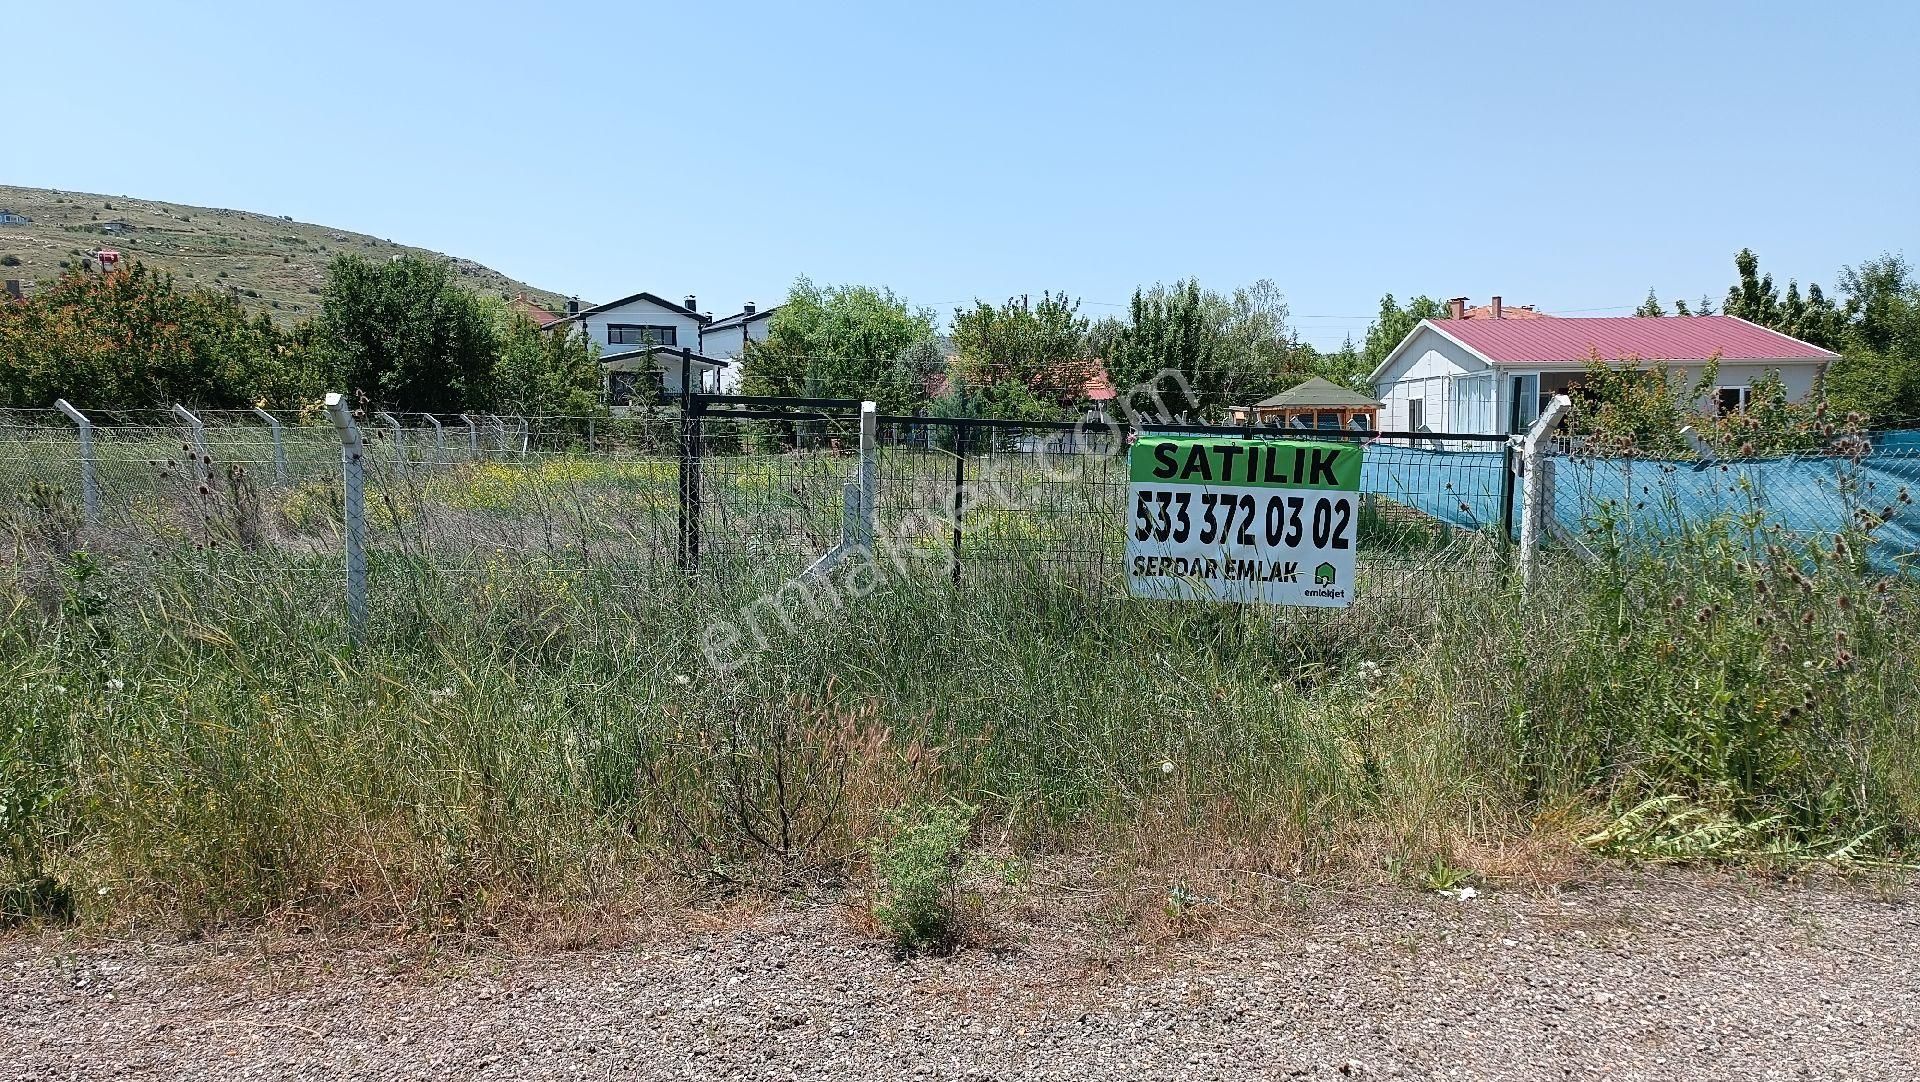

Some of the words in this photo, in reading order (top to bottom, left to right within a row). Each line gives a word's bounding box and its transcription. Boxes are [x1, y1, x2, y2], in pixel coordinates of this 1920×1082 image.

[1152, 443, 1340, 486] SATILIK
[1135, 491, 1191, 543] 533
[1199, 493, 1256, 546] 372
[1265, 496, 1304, 548] 03
[1312, 497, 1351, 549] 02
[1132, 555, 1217, 580] SERDAR
[1224, 559, 1298, 583] EMLAK
